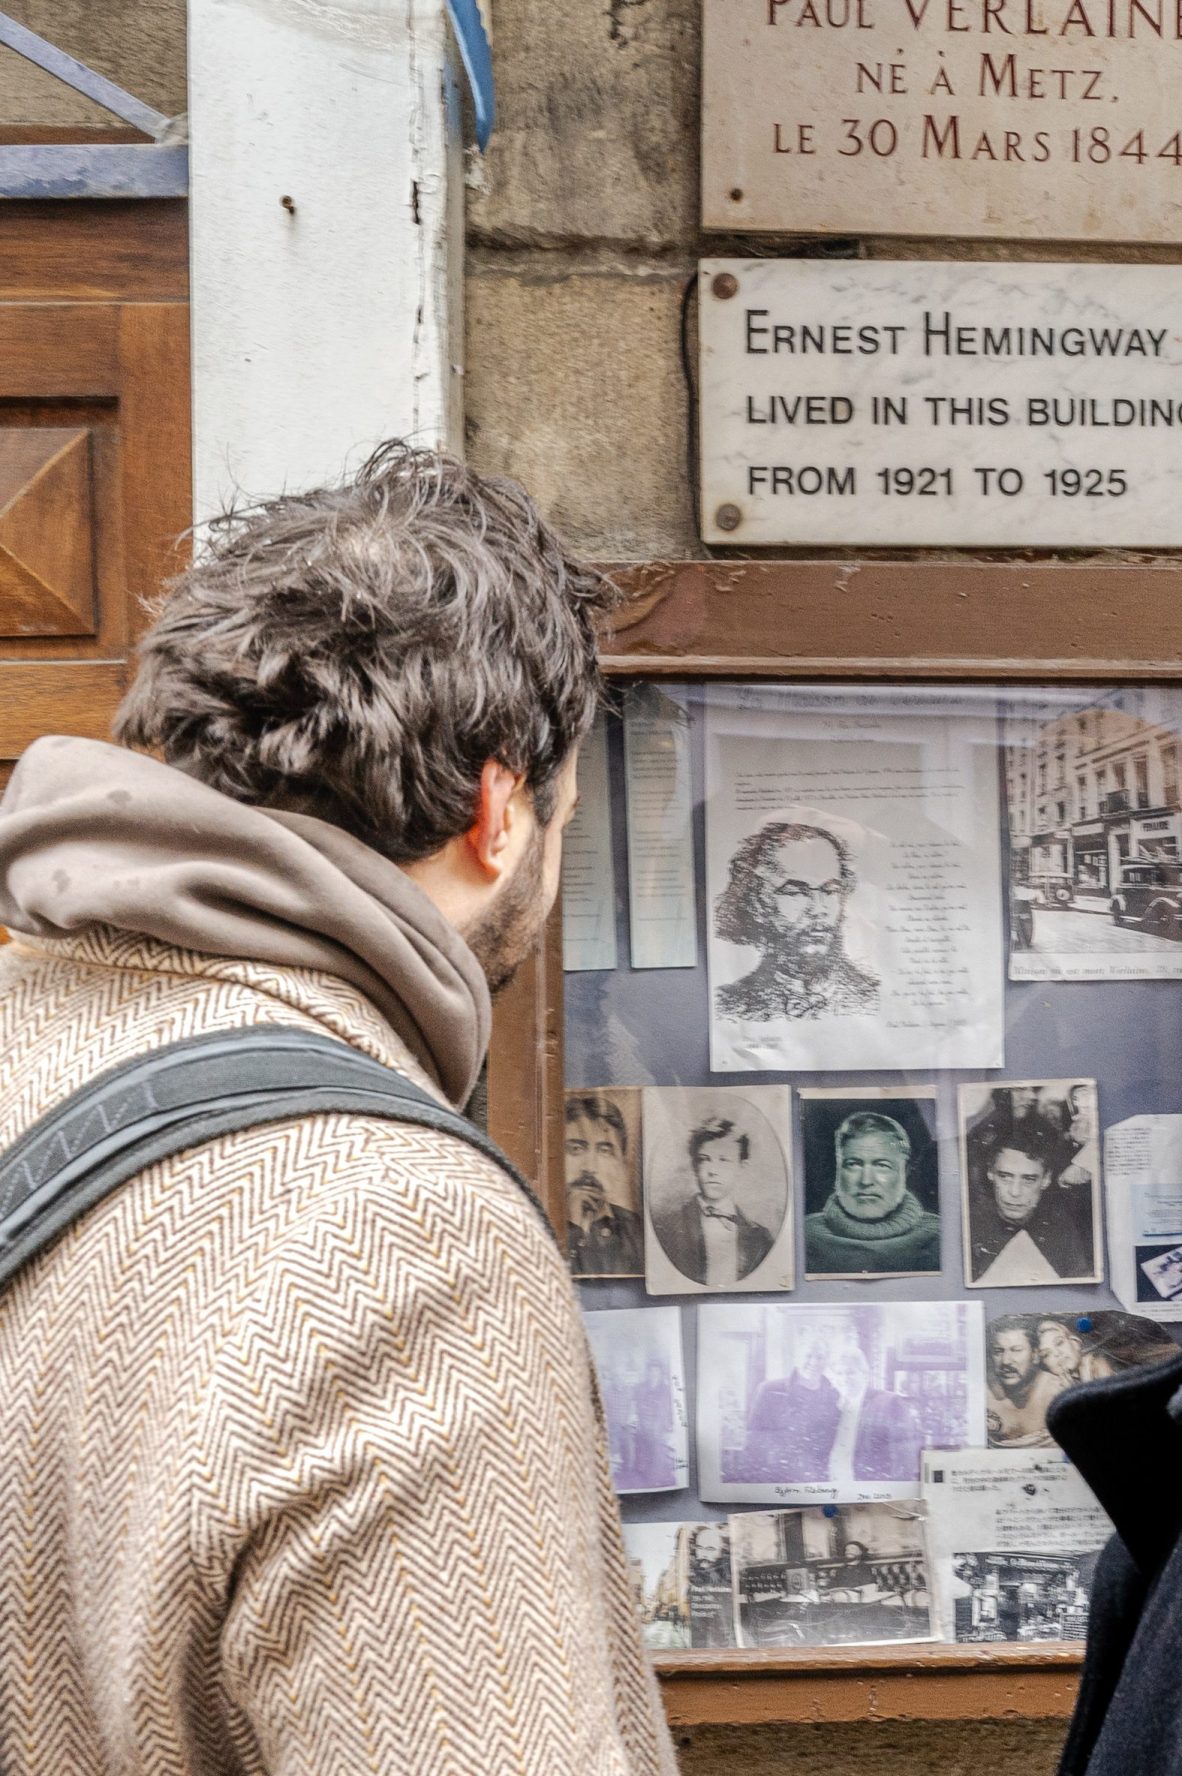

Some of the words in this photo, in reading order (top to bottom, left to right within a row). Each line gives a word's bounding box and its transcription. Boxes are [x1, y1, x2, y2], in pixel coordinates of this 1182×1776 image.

[766, 0, 876, 29] PAUL
[855, 47, 909, 95] NÉ
[929, 50, 956, 96] À
[773, 123, 817, 155] LE
[837, 118, 899, 158] 30
[921, 114, 1051, 163] MARS
[745, 308, 907, 355] ERNEST
[923, 311, 1168, 357] HEMINGWAY
[746, 395, 856, 425] LIVED
[871, 396, 908, 426] IN
[923, 396, 1011, 427] THIS
[748, 465, 856, 496] FROM
[876, 467, 954, 497] 1921
[973, 467, 1025, 497] TO
[1043, 468, 1128, 498] 1925
